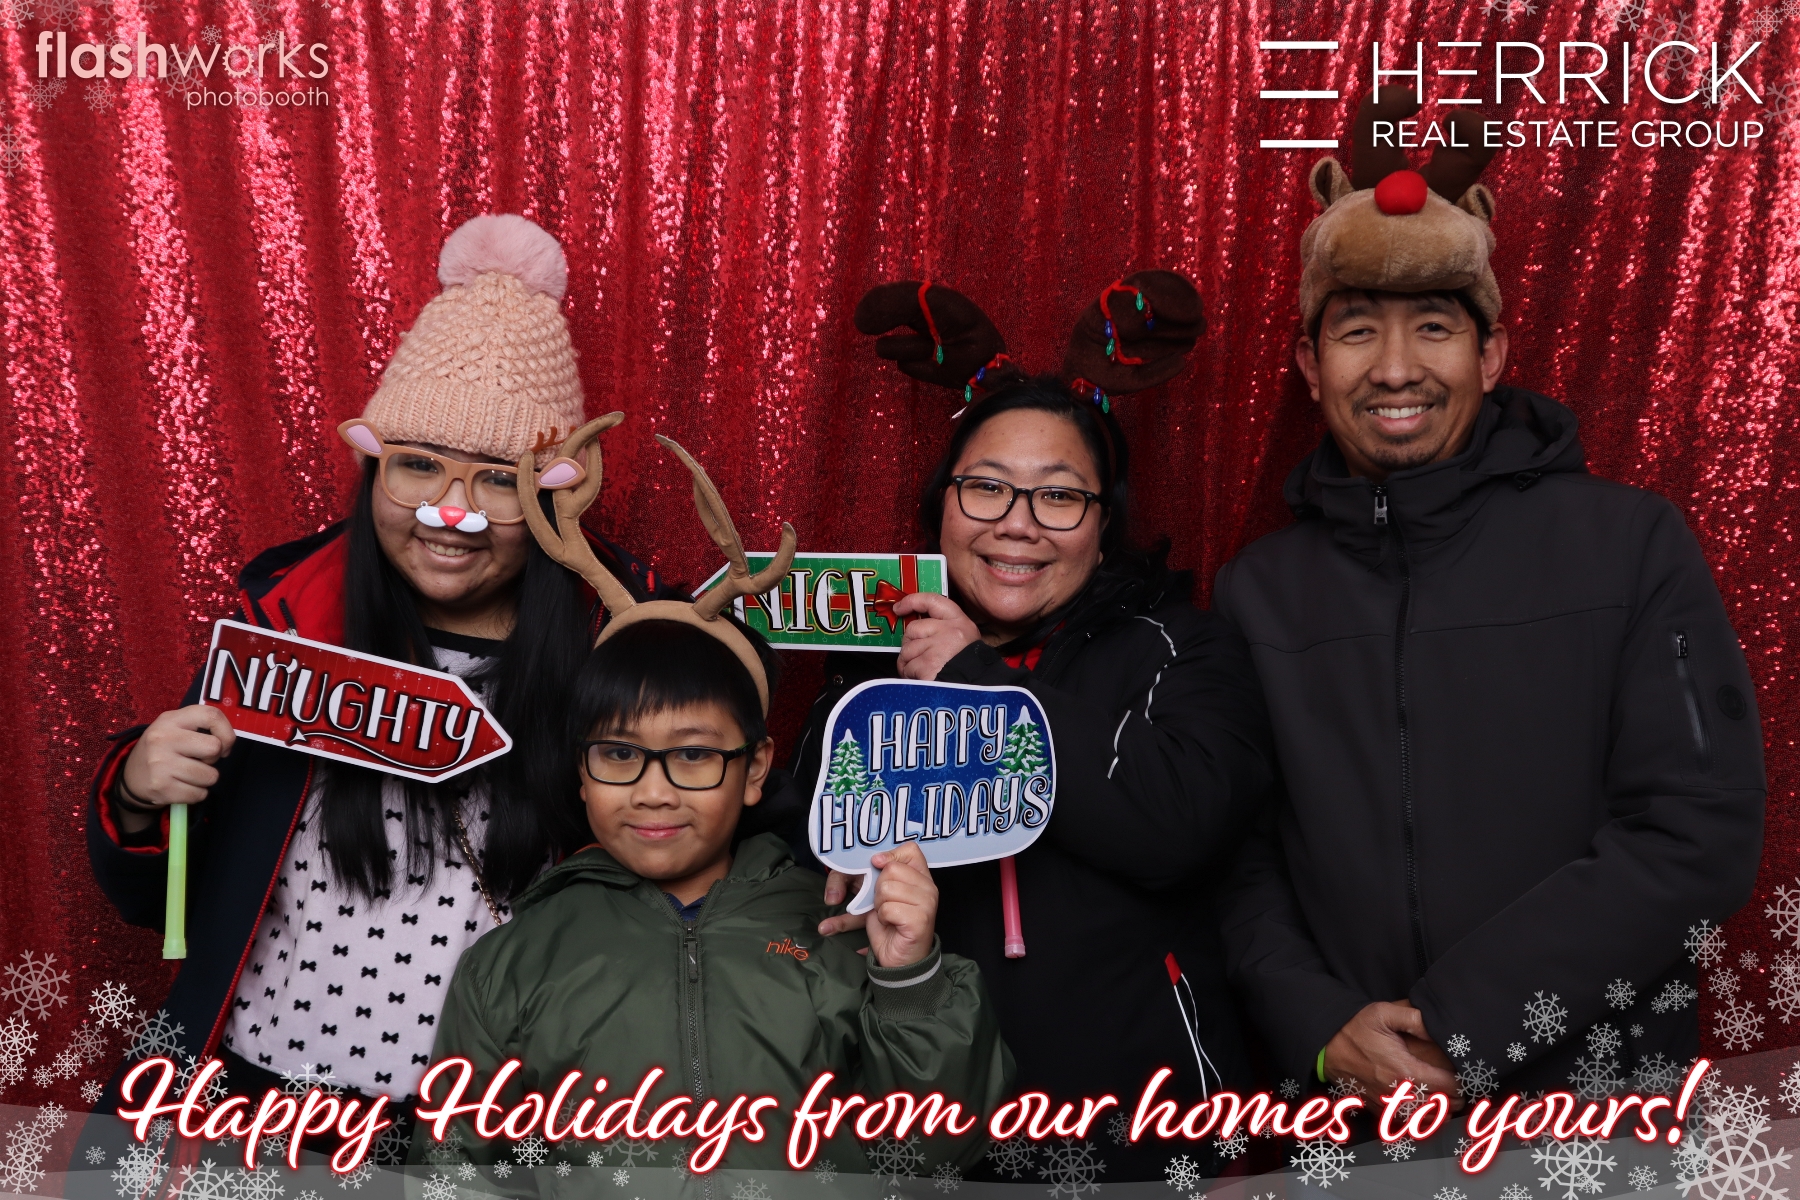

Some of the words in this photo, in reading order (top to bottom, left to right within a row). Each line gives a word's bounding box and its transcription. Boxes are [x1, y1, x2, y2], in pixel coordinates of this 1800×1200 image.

[206, 648, 482, 772] NAUGHTY
[870, 704, 1008, 774] HAPPY
[819, 774, 1050, 854] HOLIDAYS
[765, 937, 809, 961] nike
